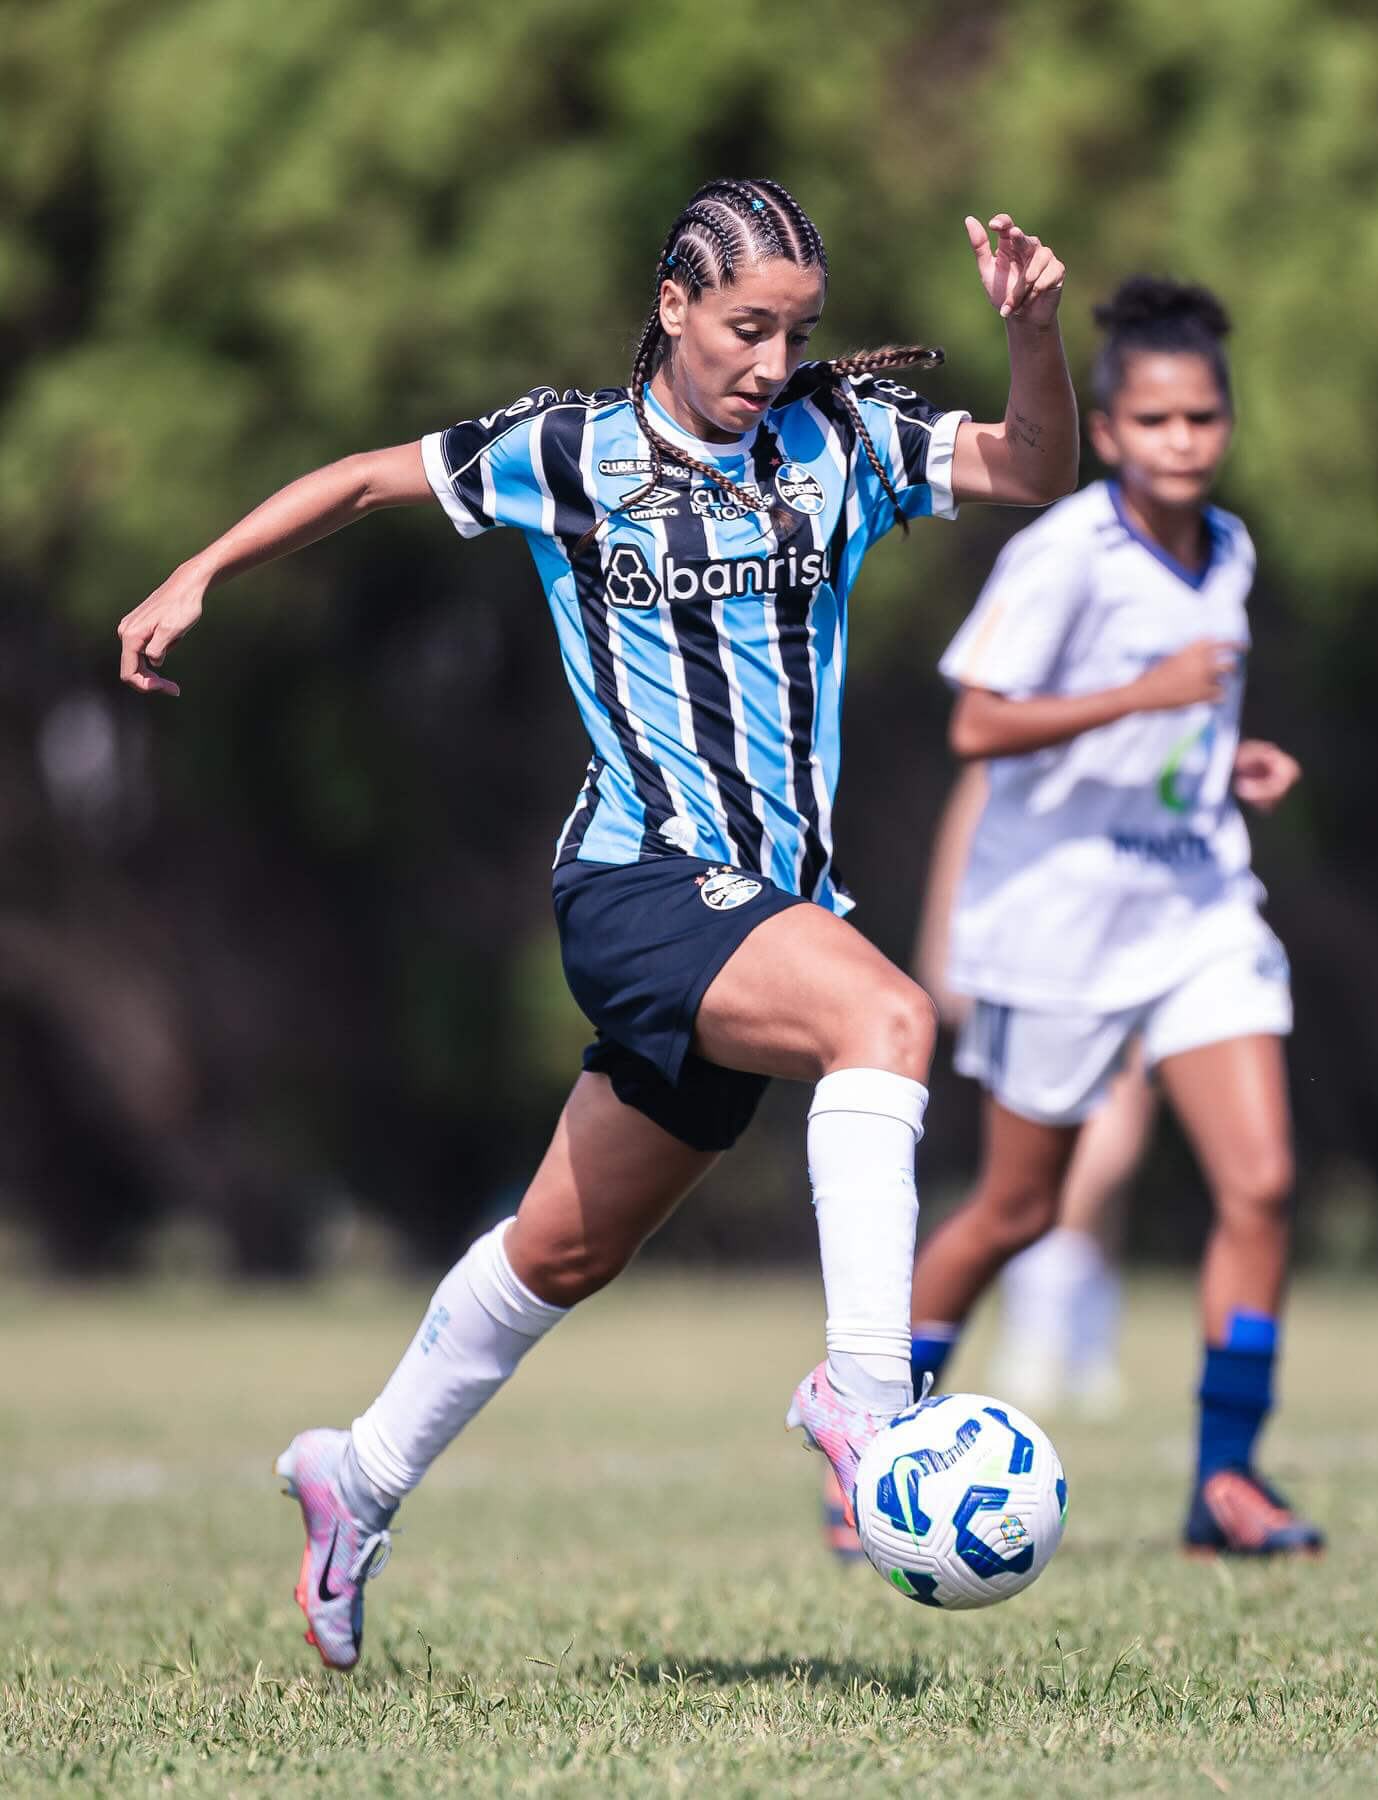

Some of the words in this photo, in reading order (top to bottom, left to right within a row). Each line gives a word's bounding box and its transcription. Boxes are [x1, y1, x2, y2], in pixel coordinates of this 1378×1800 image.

[599, 461, 635, 473] CLUBE
[636, 461, 652, 471] DE
[710, 493, 776, 520] TODS
[630, 507, 679, 519] umbro
